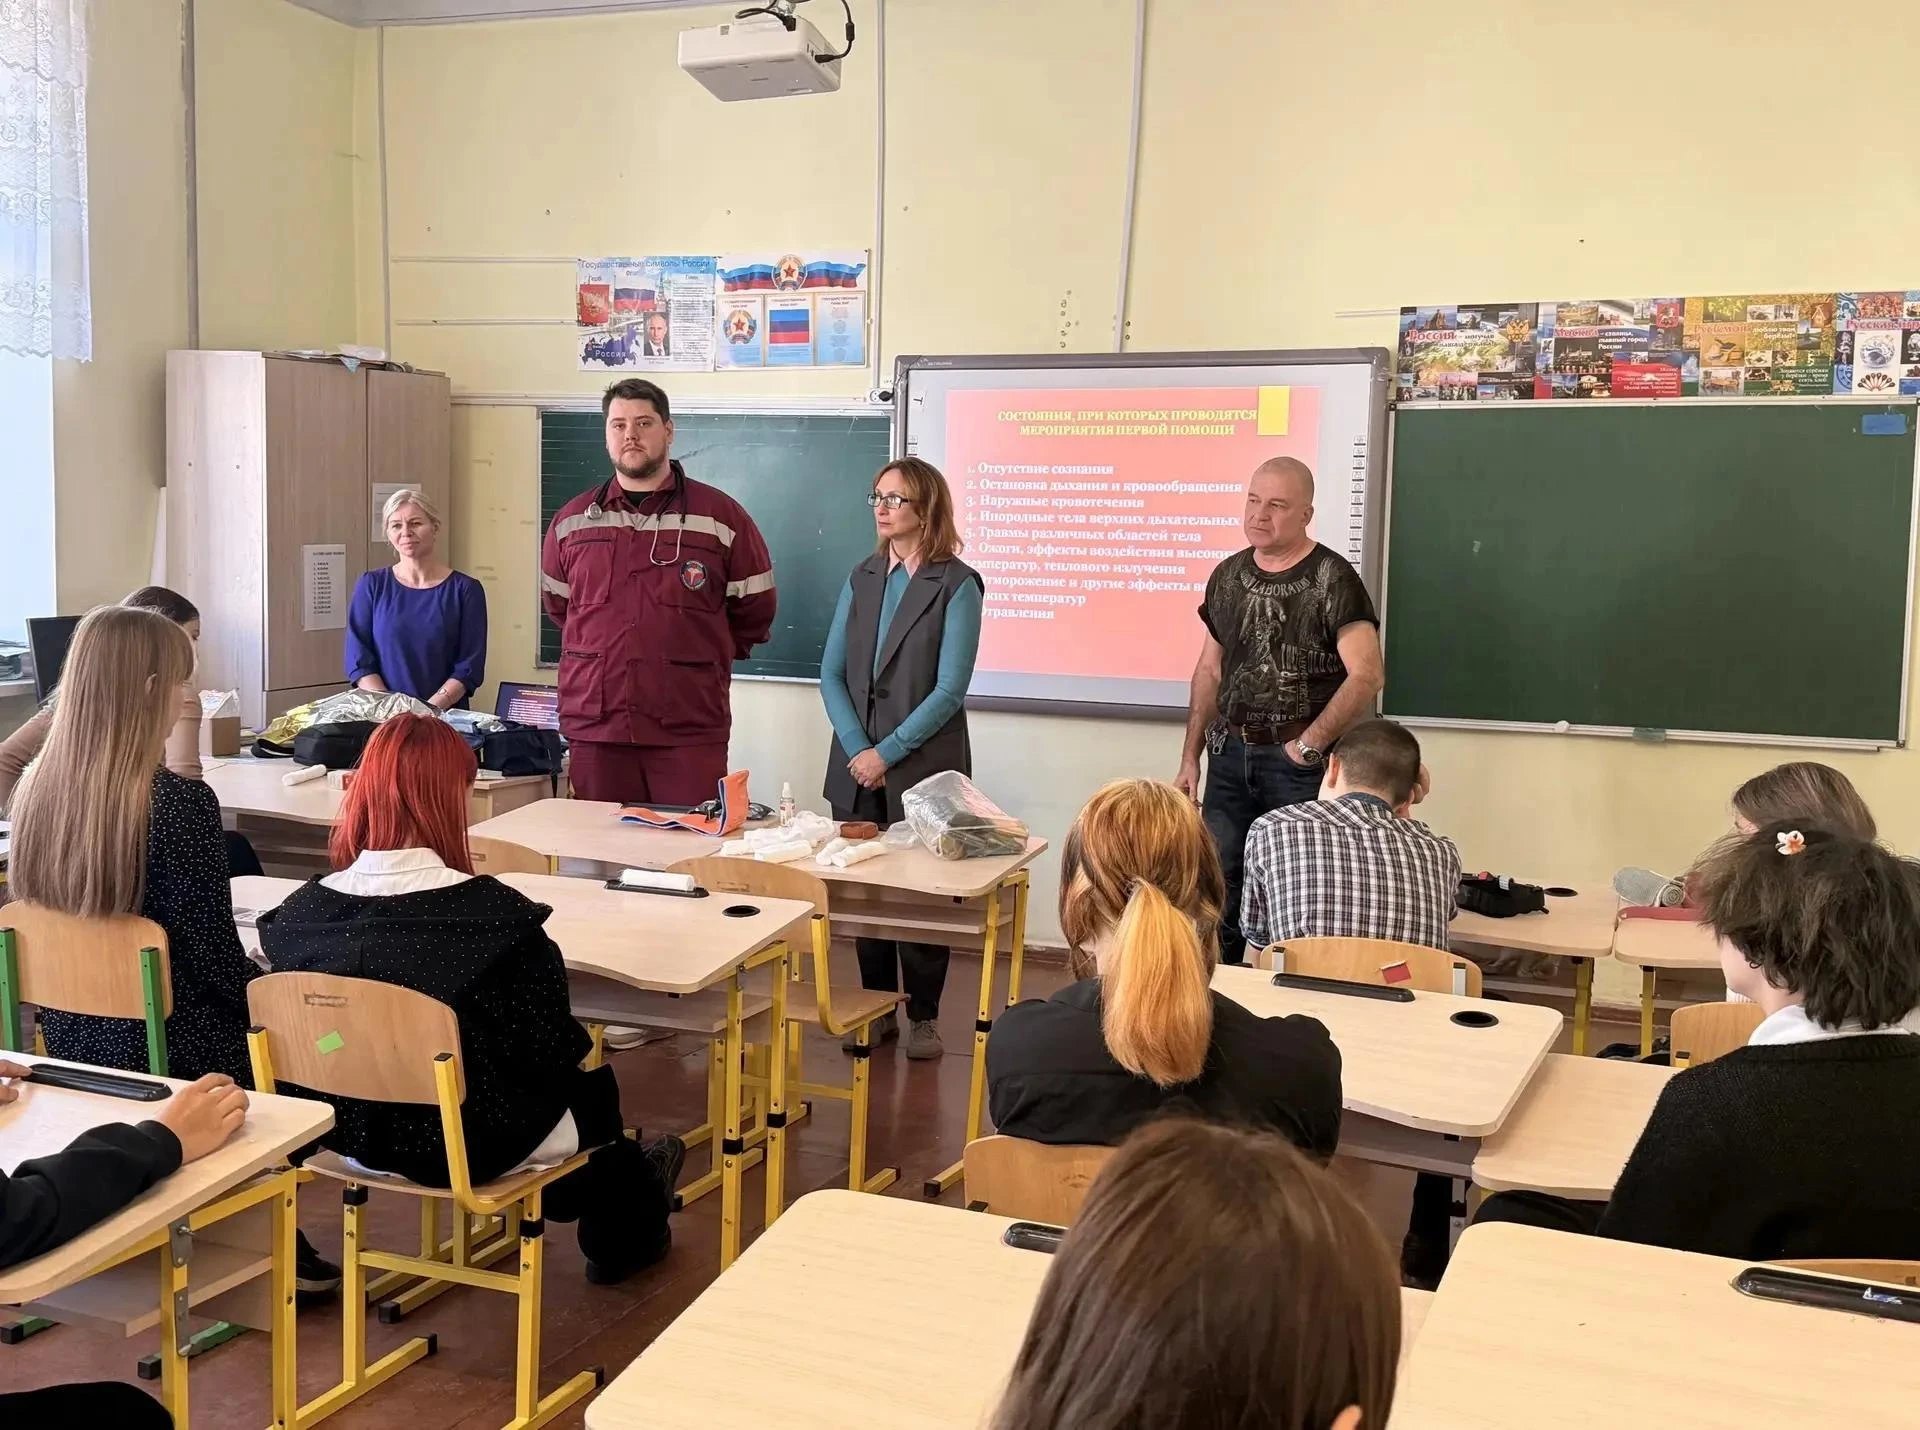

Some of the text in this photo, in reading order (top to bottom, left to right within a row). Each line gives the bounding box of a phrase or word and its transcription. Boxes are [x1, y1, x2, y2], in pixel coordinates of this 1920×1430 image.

[1406, 329, 1456, 342] Россия
[595, 350, 626, 358] Россия
[998, 409, 1258, 422] СОСТОЯНИЯ, ПРИ КОТОРЫХ ПРОВОДЯТСЯ
[1020, 423, 1235, 437] МЕРОПРИЯТИЯ ПЕРВОЙ ПОМОЩИ
[978, 462, 1049, 476] Отсутствие
[1051, 464, 1114, 475] сознания
[966, 478, 1243, 493] 2. Остановка дыхания и кровообращения
[965, 494, 1145, 510] 3. Наружные кровотечения
[965, 511, 1241, 527] 4. Инородные тела верхних дыхательных
[964, 526, 1202, 542] 5. Травмы различных областей тела
[979, 542, 1023, 555] Ожоги,
[1027, 544, 1088, 557] эффекты
[1089, 547, 1175, 559] воздействия
[1044, 560, 1110, 573] теплового
[1113, 563, 1186, 576] излучения
[1069, 579, 1077, 588] и
[1080, 579, 1125, 592] другие
[1127, 579, 1191, 593] эффекты
[1011, 593, 1087, 607] температур
